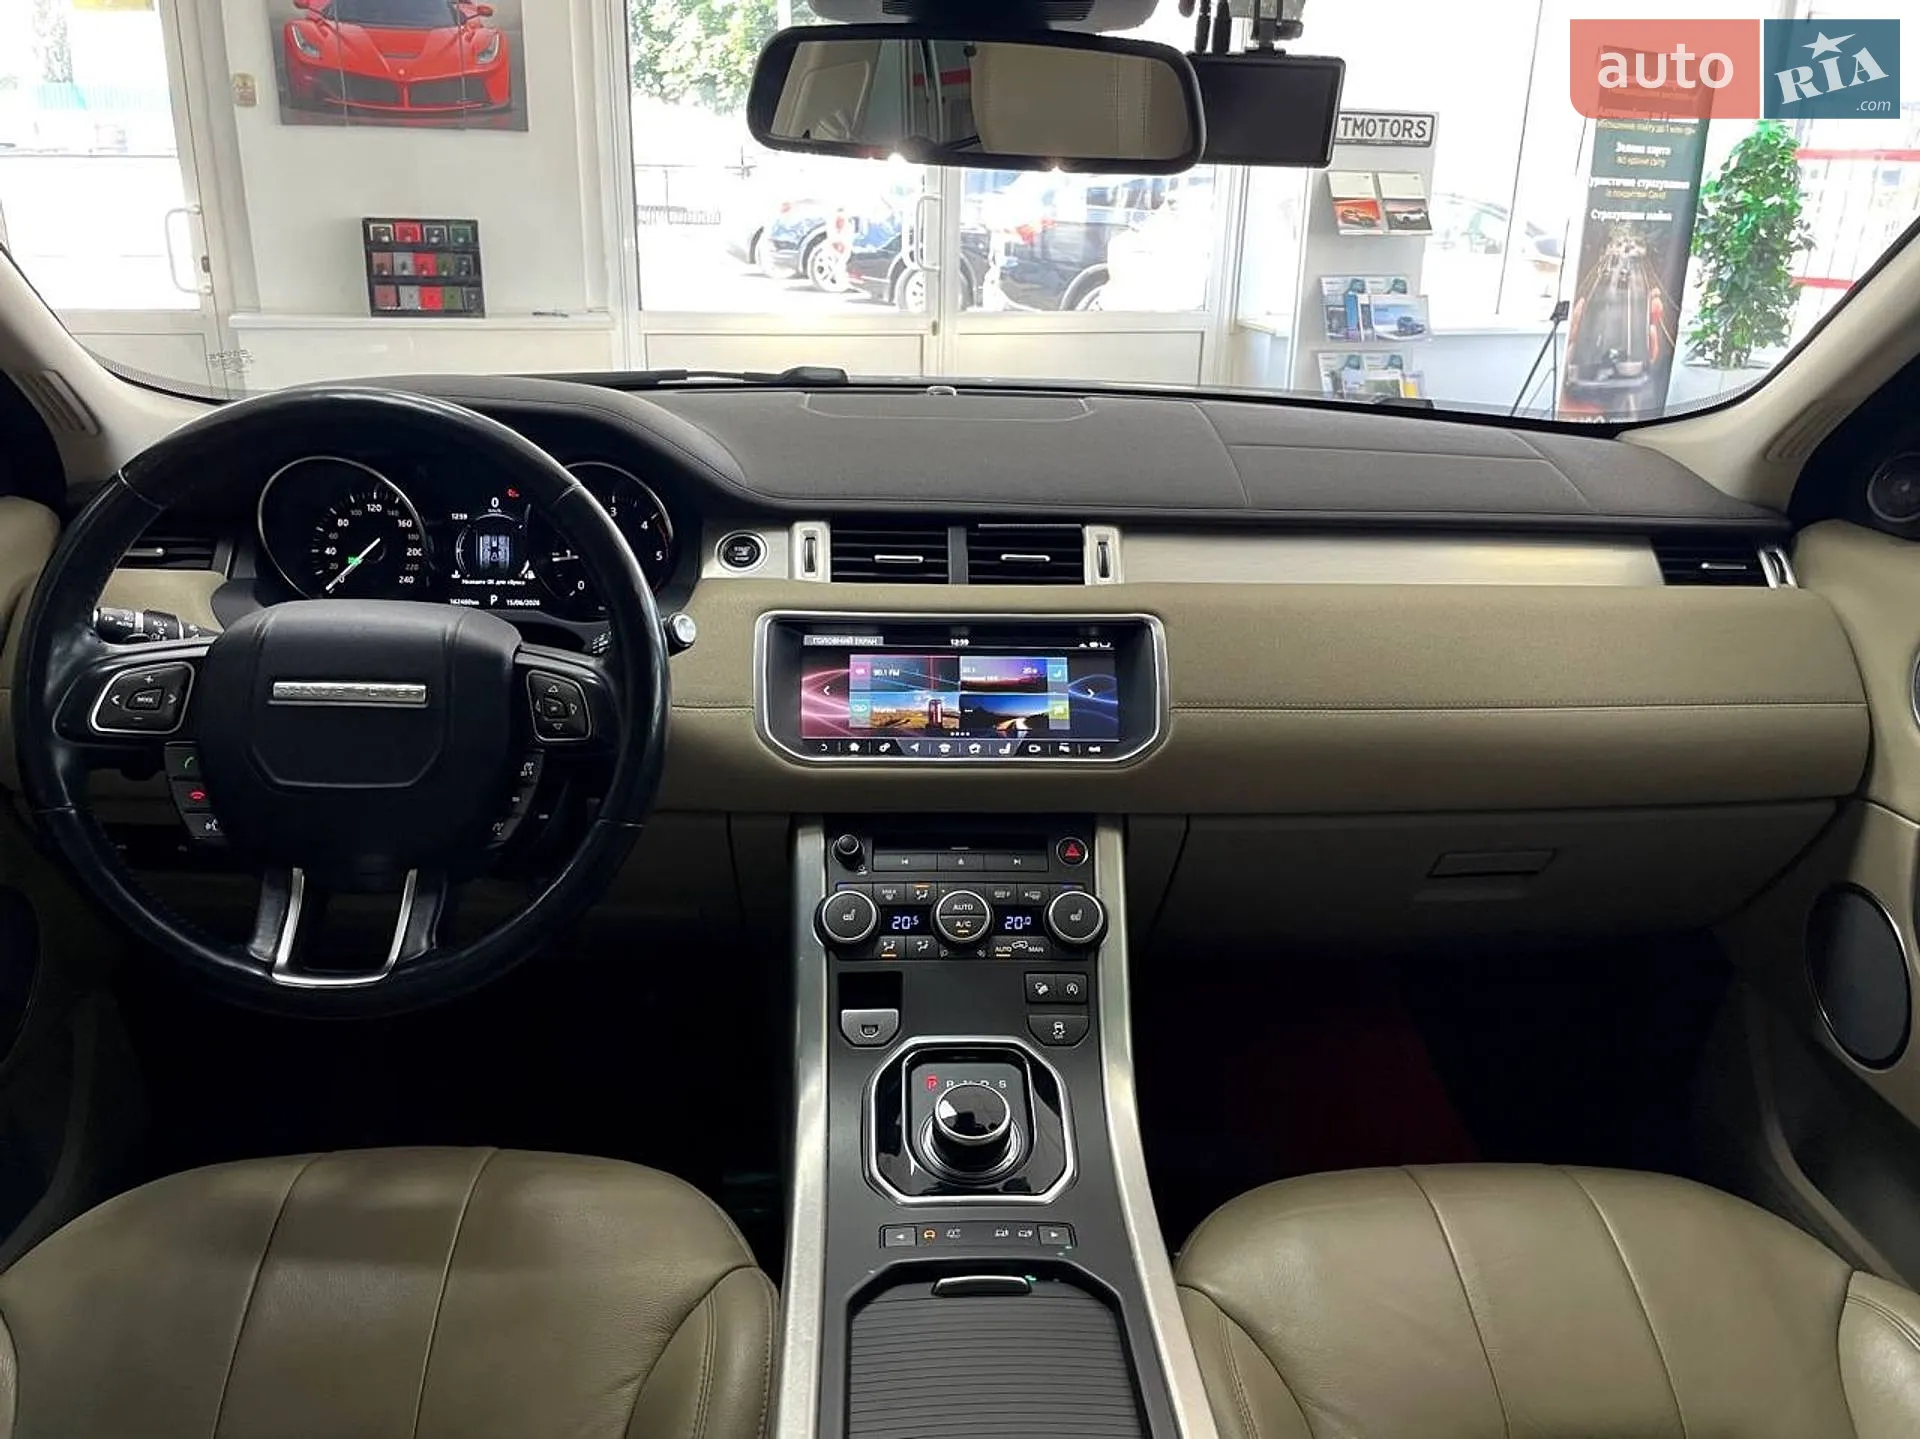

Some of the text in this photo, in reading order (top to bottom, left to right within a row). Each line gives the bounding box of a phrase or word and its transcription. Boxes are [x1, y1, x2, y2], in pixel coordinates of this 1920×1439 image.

[1341, 116, 1427, 138] TMOTORS
[491, 496, 500, 508] 0
[366, 503, 382, 513] 120
[610, 507, 617, 517] 3
[337, 518, 349, 527] 80
[397, 518, 413, 528] 160
[640, 520, 648, 530] 4
[324, 546, 337, 556] 40
[655, 550, 663, 561] 5
[398, 575, 414, 584] 240
[577, 580, 585, 590] 0
[490, 594, 498, 605] P
[891, 915, 919, 930] 20.5
[955, 920, 972, 928] A/C
[1004, 915, 1032, 930] 20.0
